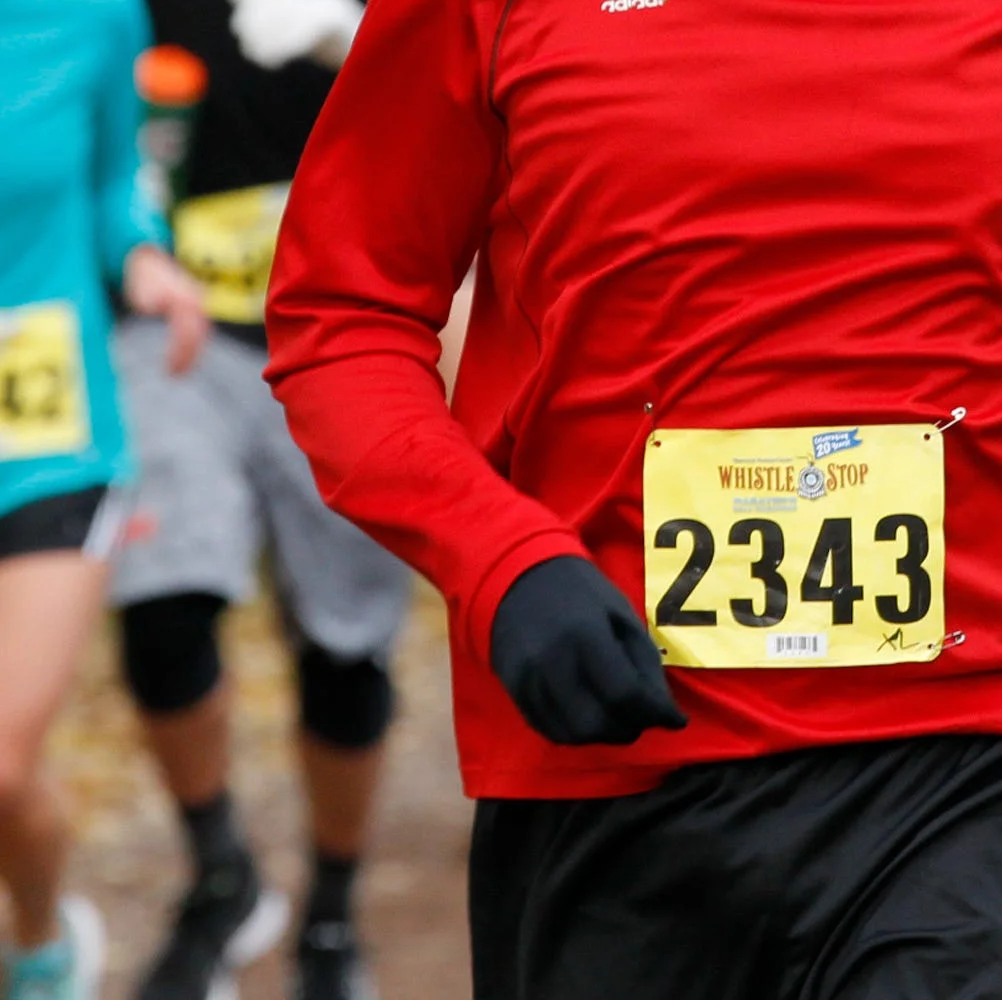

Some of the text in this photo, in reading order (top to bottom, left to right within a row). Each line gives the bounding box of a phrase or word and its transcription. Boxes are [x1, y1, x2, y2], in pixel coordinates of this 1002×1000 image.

[816, 442, 831, 457] 20
[718, 463, 869, 492] WHISTLE STOP
[654, 513, 932, 628] 2343
